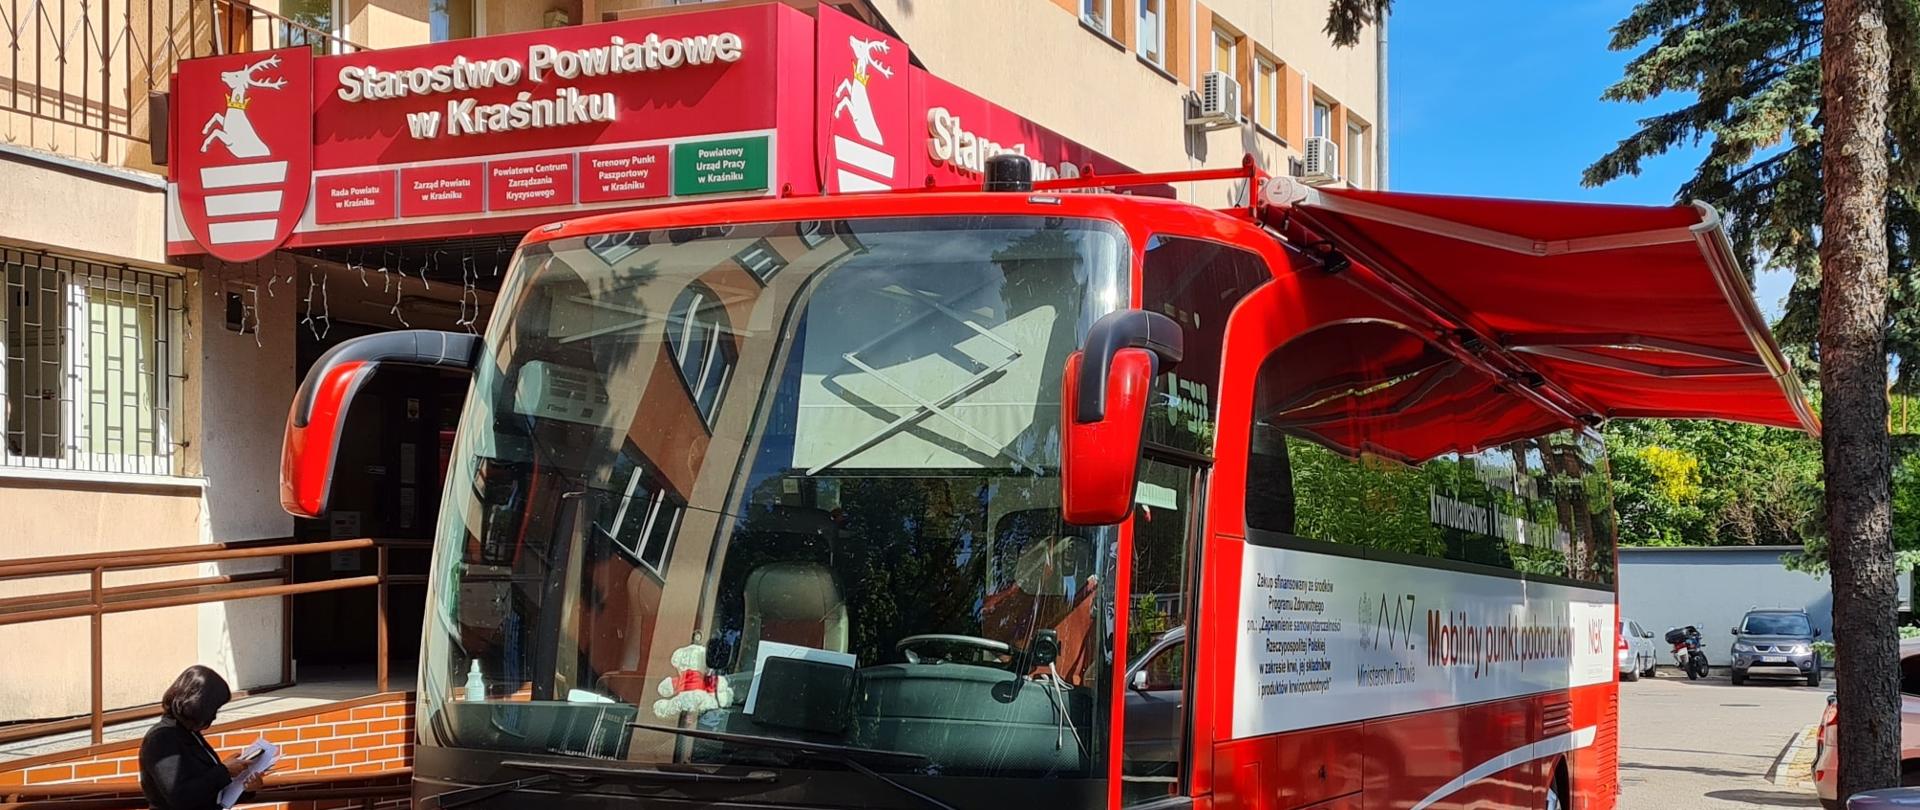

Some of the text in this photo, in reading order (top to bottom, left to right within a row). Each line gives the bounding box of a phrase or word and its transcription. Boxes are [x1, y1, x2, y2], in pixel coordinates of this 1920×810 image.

[338, 31, 742, 101] Starostwo Powiatowe
[407, 87, 616, 139] w Kraśniku
[927, 107, 1059, 181] Starwo
[698, 147, 743, 158] Powiatowy
[592, 155, 655, 168] Terenowy Punkt
[696, 158, 745, 171] Urząd Pracy
[493, 162, 568, 177] Powiatowe Centrum
[599, 169, 648, 180] Paszportowy
[508, 176, 553, 188] Zarządzania
[708, 172, 743, 182] Kraśniku
[413, 178, 471, 190] Zarząd Powiatu
[611, 181, 645, 191] Kraśniku
[331, 186, 380, 197] Rada Powiatu
[430, 191, 462, 201] Kraśniku
[506, 189, 555, 201] Kryzysowego
[344, 198, 375, 208] Kraśniku
[1257, 572, 1333, 594] Zakup sfinansowany ze środków
[1268, 595, 1324, 615] Programu Zdrowotnego
[1266, 637, 1326, 656] Rzeczypospolitej Polskiej
[1427, 609, 1575, 679] Mobilny punkt poboru krwi
[1265, 660, 1286, 674] zakresie
[1306, 658, 1331, 672] składników
[1357, 660, 1415, 688] Ministerstwo Zdrowia
[1261, 680, 1288, 699] produktów
